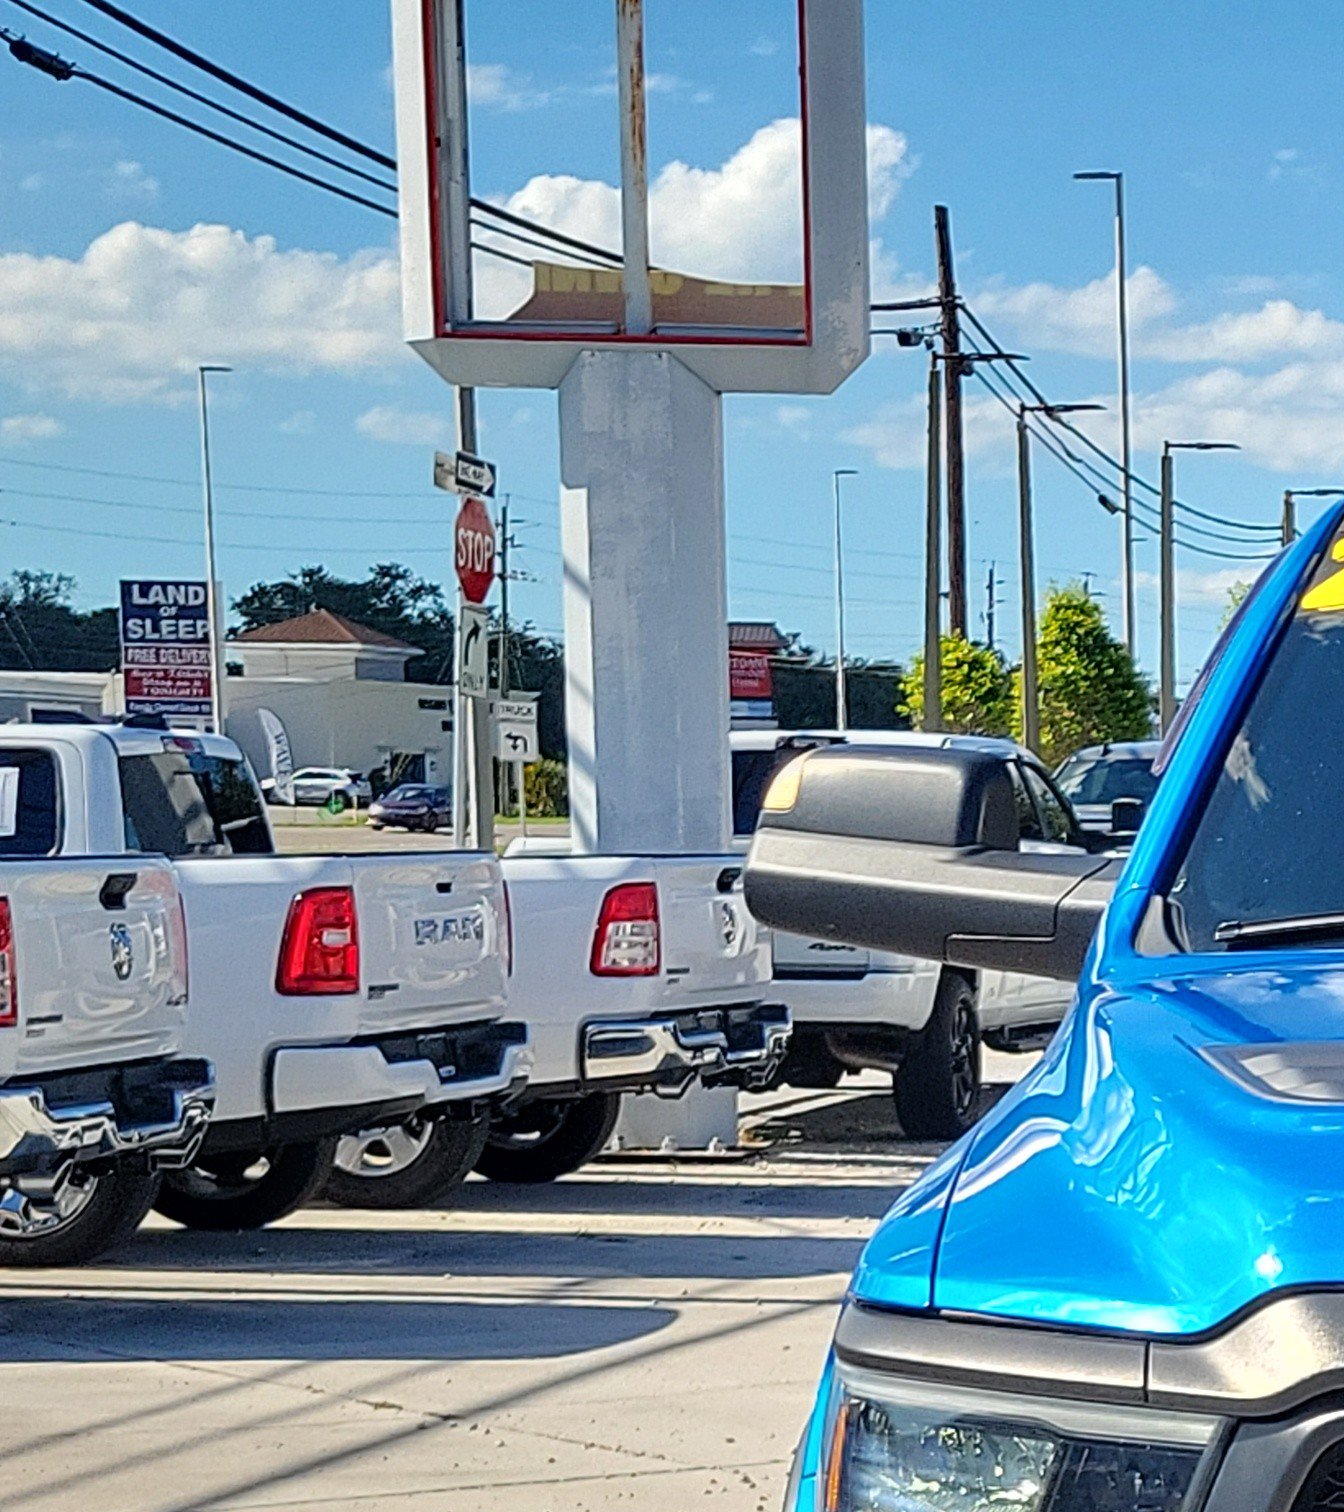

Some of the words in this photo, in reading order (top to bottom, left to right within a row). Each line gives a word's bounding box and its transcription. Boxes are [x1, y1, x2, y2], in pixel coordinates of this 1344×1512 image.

[457, 527, 494, 573] STOP
[131, 584, 205, 606] LAND
[159, 606, 178, 616] OF
[126, 618, 210, 640] SLEEP
[127, 648, 157, 663] FREE
